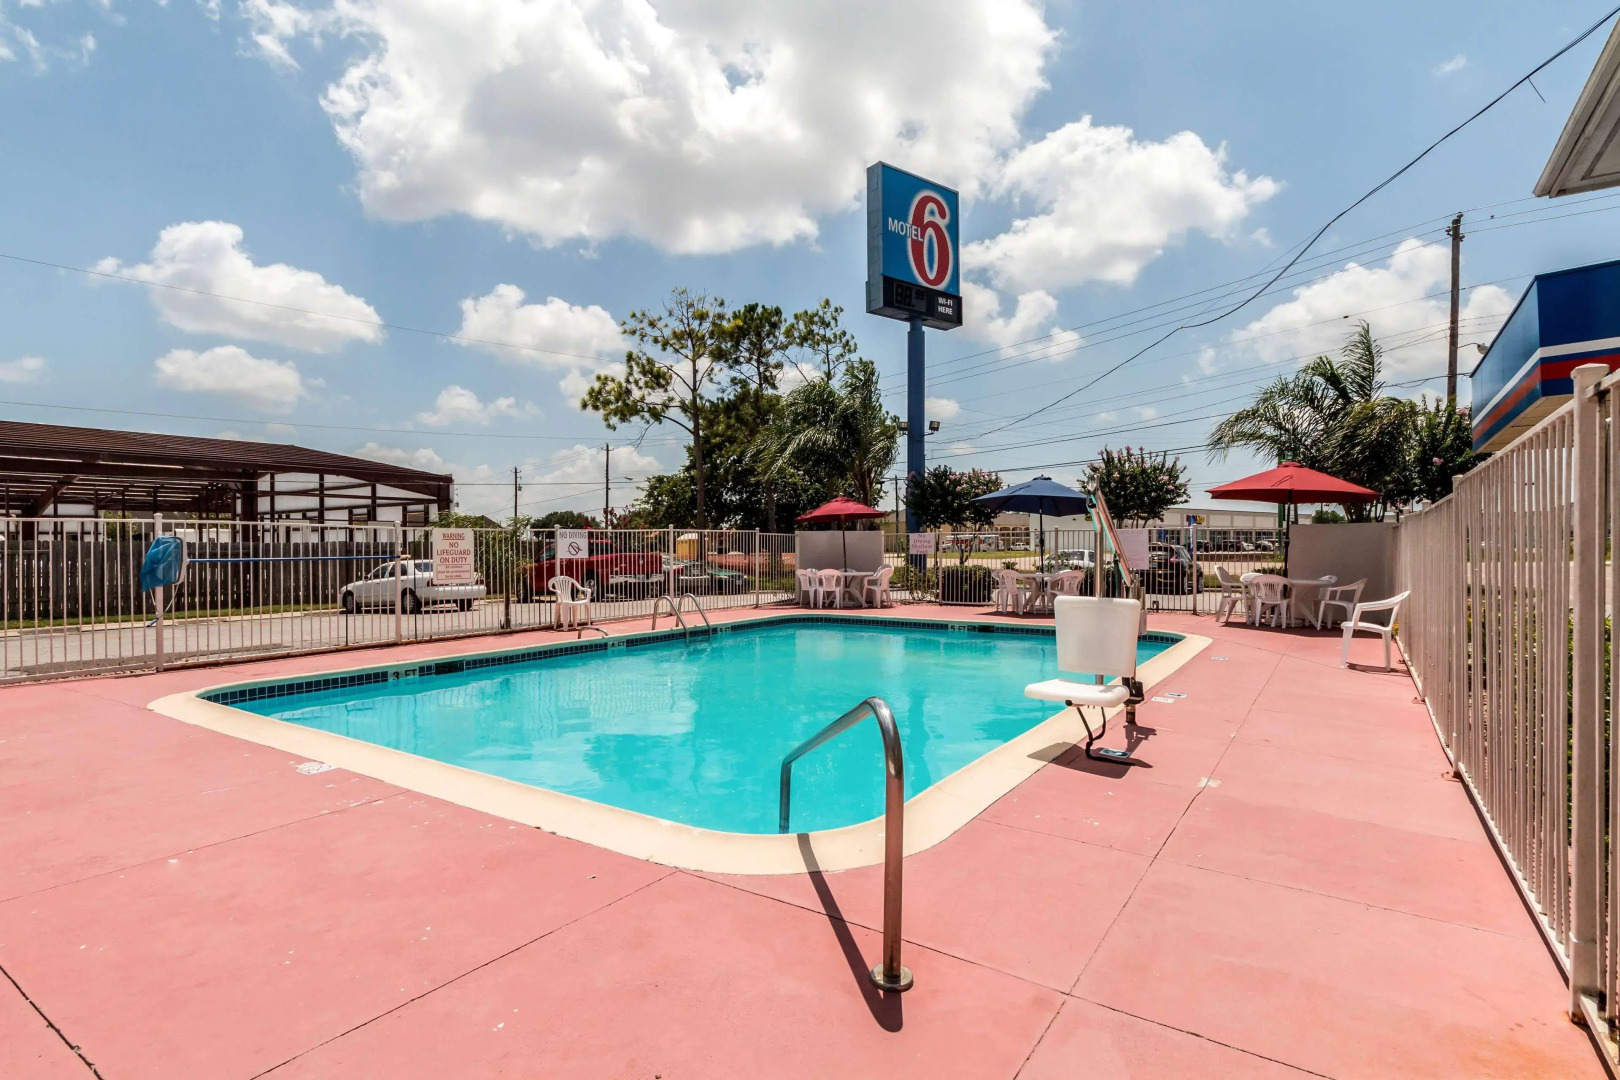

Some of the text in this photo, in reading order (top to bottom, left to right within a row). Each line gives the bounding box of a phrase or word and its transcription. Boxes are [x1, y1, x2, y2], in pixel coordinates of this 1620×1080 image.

[888, 193, 951, 288] MOTEL 6
[938, 306, 953, 315] HERE
[569, 531, 587, 539] DIVING
[393, 671, 400, 680] 3
